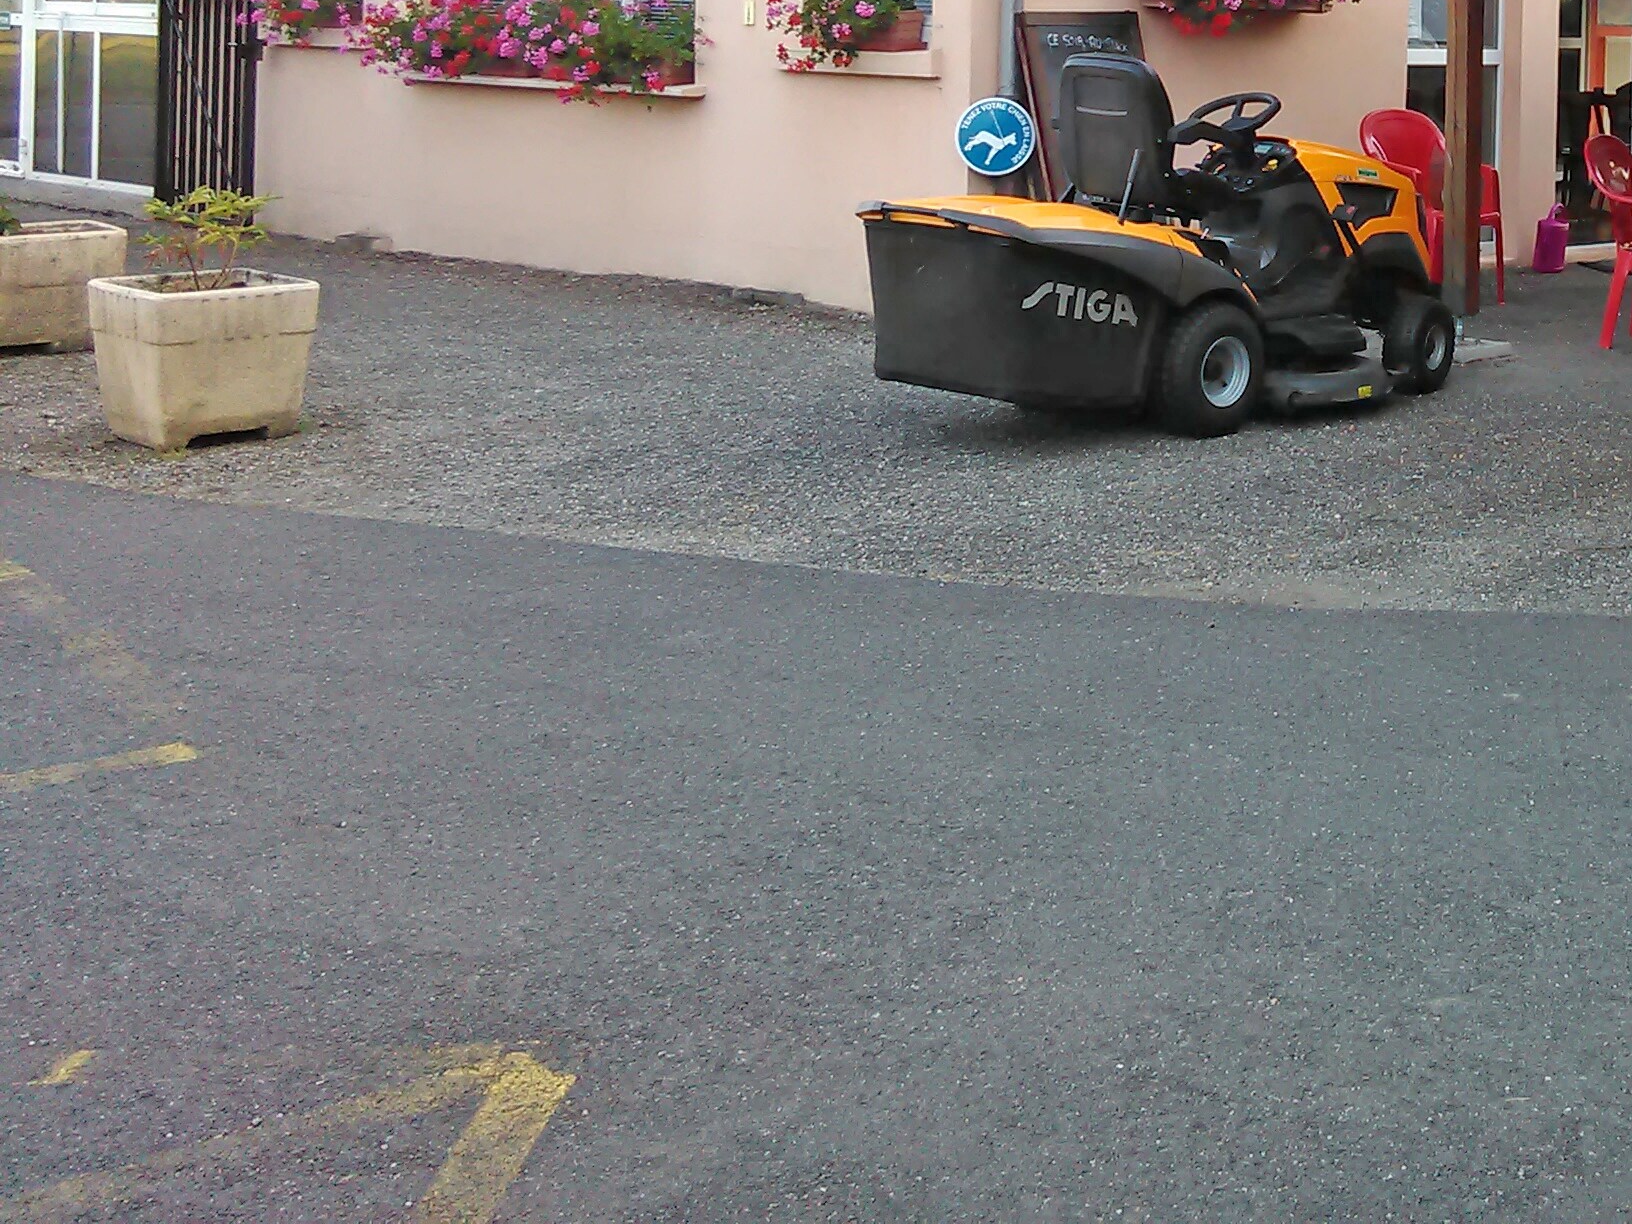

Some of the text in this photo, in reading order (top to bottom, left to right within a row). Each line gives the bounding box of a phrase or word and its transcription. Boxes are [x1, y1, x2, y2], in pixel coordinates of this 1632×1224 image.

[961, 107, 982, 129] TENEZ
[981, 102, 1008, 112] VOTRE
[1007, 106, 1028, 126] CHIEN
[1010, 138, 1031, 164] LAISSE
[1021, 281, 1139, 327] STIGA
